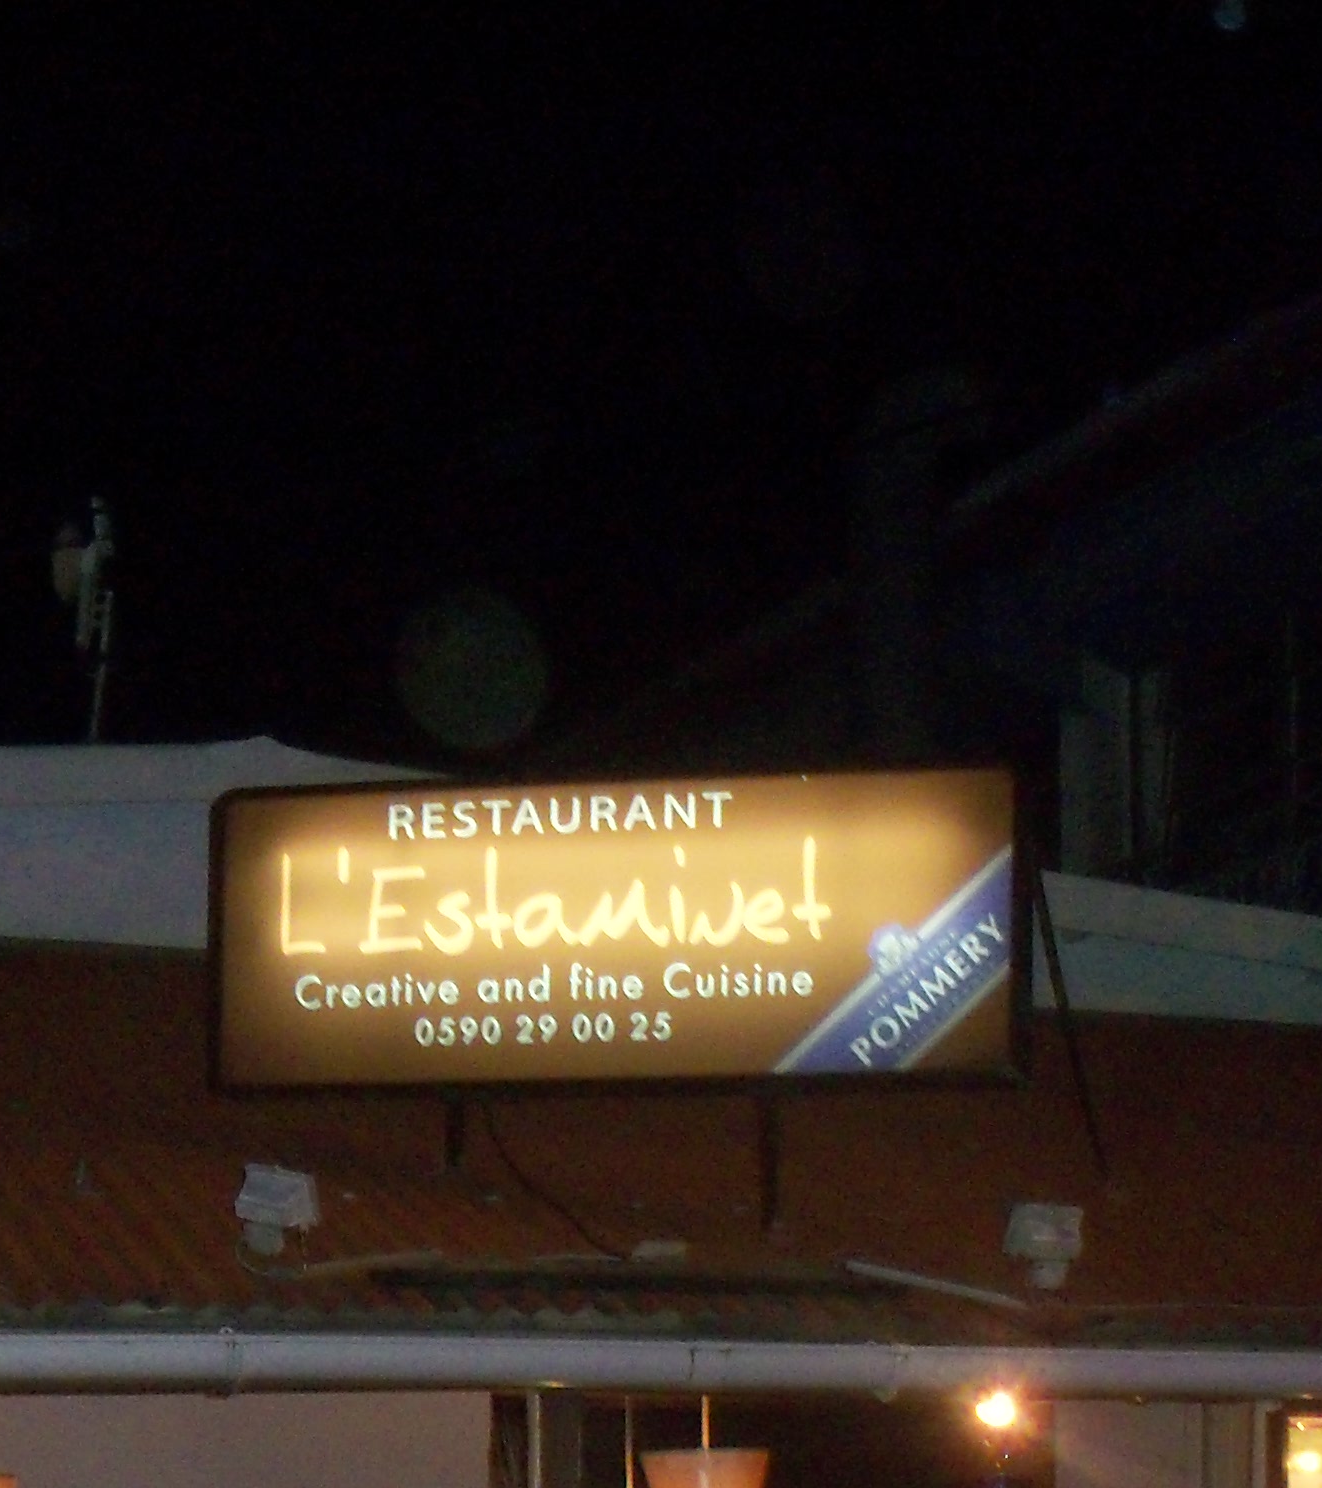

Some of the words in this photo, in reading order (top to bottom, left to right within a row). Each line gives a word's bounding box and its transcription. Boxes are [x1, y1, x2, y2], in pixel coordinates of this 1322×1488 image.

[388, 790, 733, 841] RESTAURANT
[294, 972, 460, 1011] Creative
[477, 963, 551, 1004] and
[569, 961, 644, 1001] fine
[662, 961, 814, 1000] Cuisine
[849, 912, 1005, 1068] POMMERY
[414, 1015, 503, 1047] 0590
[515, 1012, 559, 1045] 29
[571, 1012, 616, 1044] 00
[629, 1010, 673, 1042] 25
